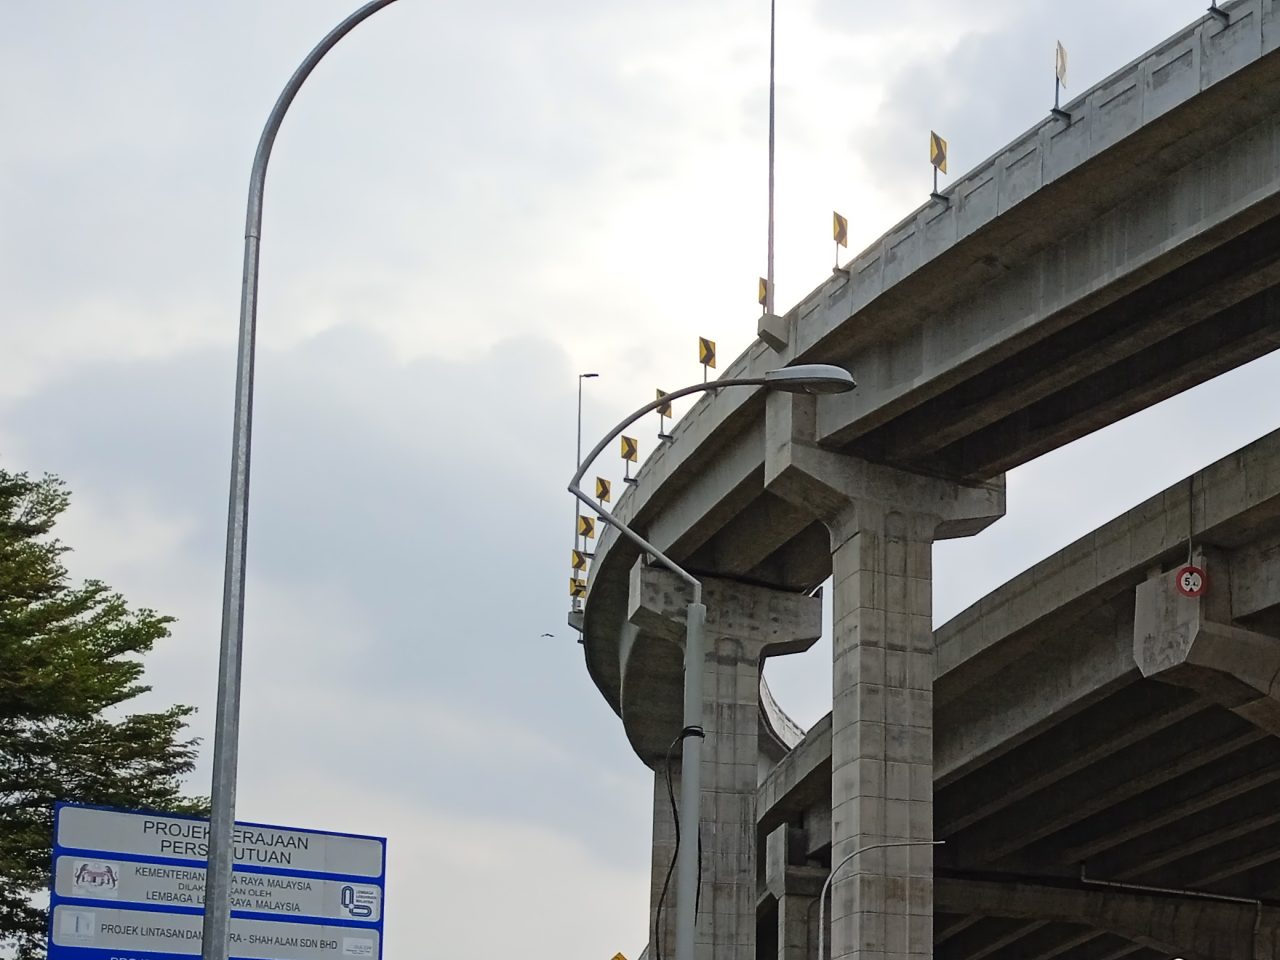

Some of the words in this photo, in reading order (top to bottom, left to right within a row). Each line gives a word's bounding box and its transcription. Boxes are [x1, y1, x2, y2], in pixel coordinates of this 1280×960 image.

[233, 830, 308, 850] ERAJAAN
[135, 867, 205, 881] KEMENTERIAN
[241, 876, 264, 887] RAYA
[267, 879, 312, 891] MALAYSIA
[146, 890, 193, 903] LEMBAGA
[256, 900, 301, 912] MALAYSIA
[248, 888, 272, 897] OLEH
[101, 924, 139, 936] PROJEK
[141, 926, 185, 939] LINTASAN
[249, 934, 273, 945] SHAH
[274, 937, 298, 947] ALAM
[300, 938, 318, 948] SDN
[319, 940, 338, 950] BHD
